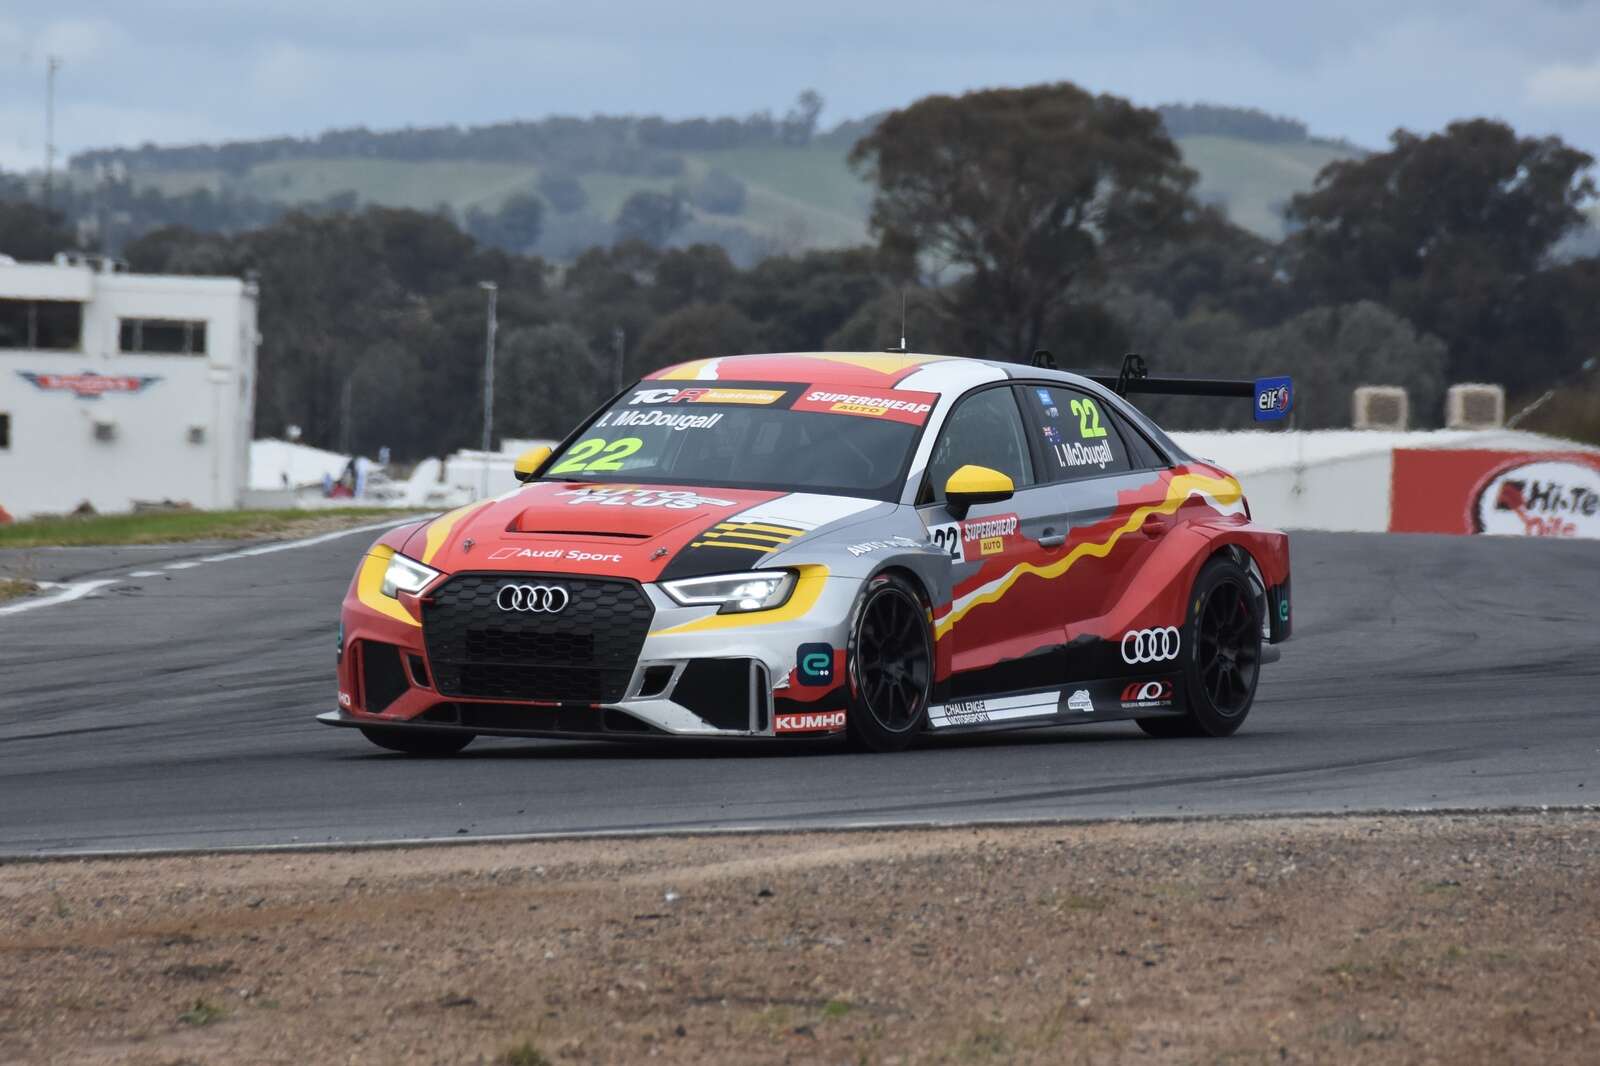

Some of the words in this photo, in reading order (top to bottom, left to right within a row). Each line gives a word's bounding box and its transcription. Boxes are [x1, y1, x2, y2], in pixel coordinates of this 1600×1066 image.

[806, 391, 932, 414] SUPERCHEAP
[1259, 389, 1278, 409] elf
[838, 404, 880, 413] AUTO
[595, 412, 610, 428] I.
[611, 410, 724, 431] McDougall
[1070, 398, 1107, 438] 22
[549, 437, 643, 474] 22
[1061, 439, 1113, 469] McDougall
[553, 488, 697, 500] AUTO
[568, 495, 698, 509] PLUS
[964, 517, 1018, 542] SUPERCHEAP
[983, 540, 1001, 550] AUTO
[517, 548, 564, 558] Audi
[565, 550, 623, 562] Sport
[944, 700, 985, 716] CHALLENGE
[776, 713, 846, 729] KUMHO
